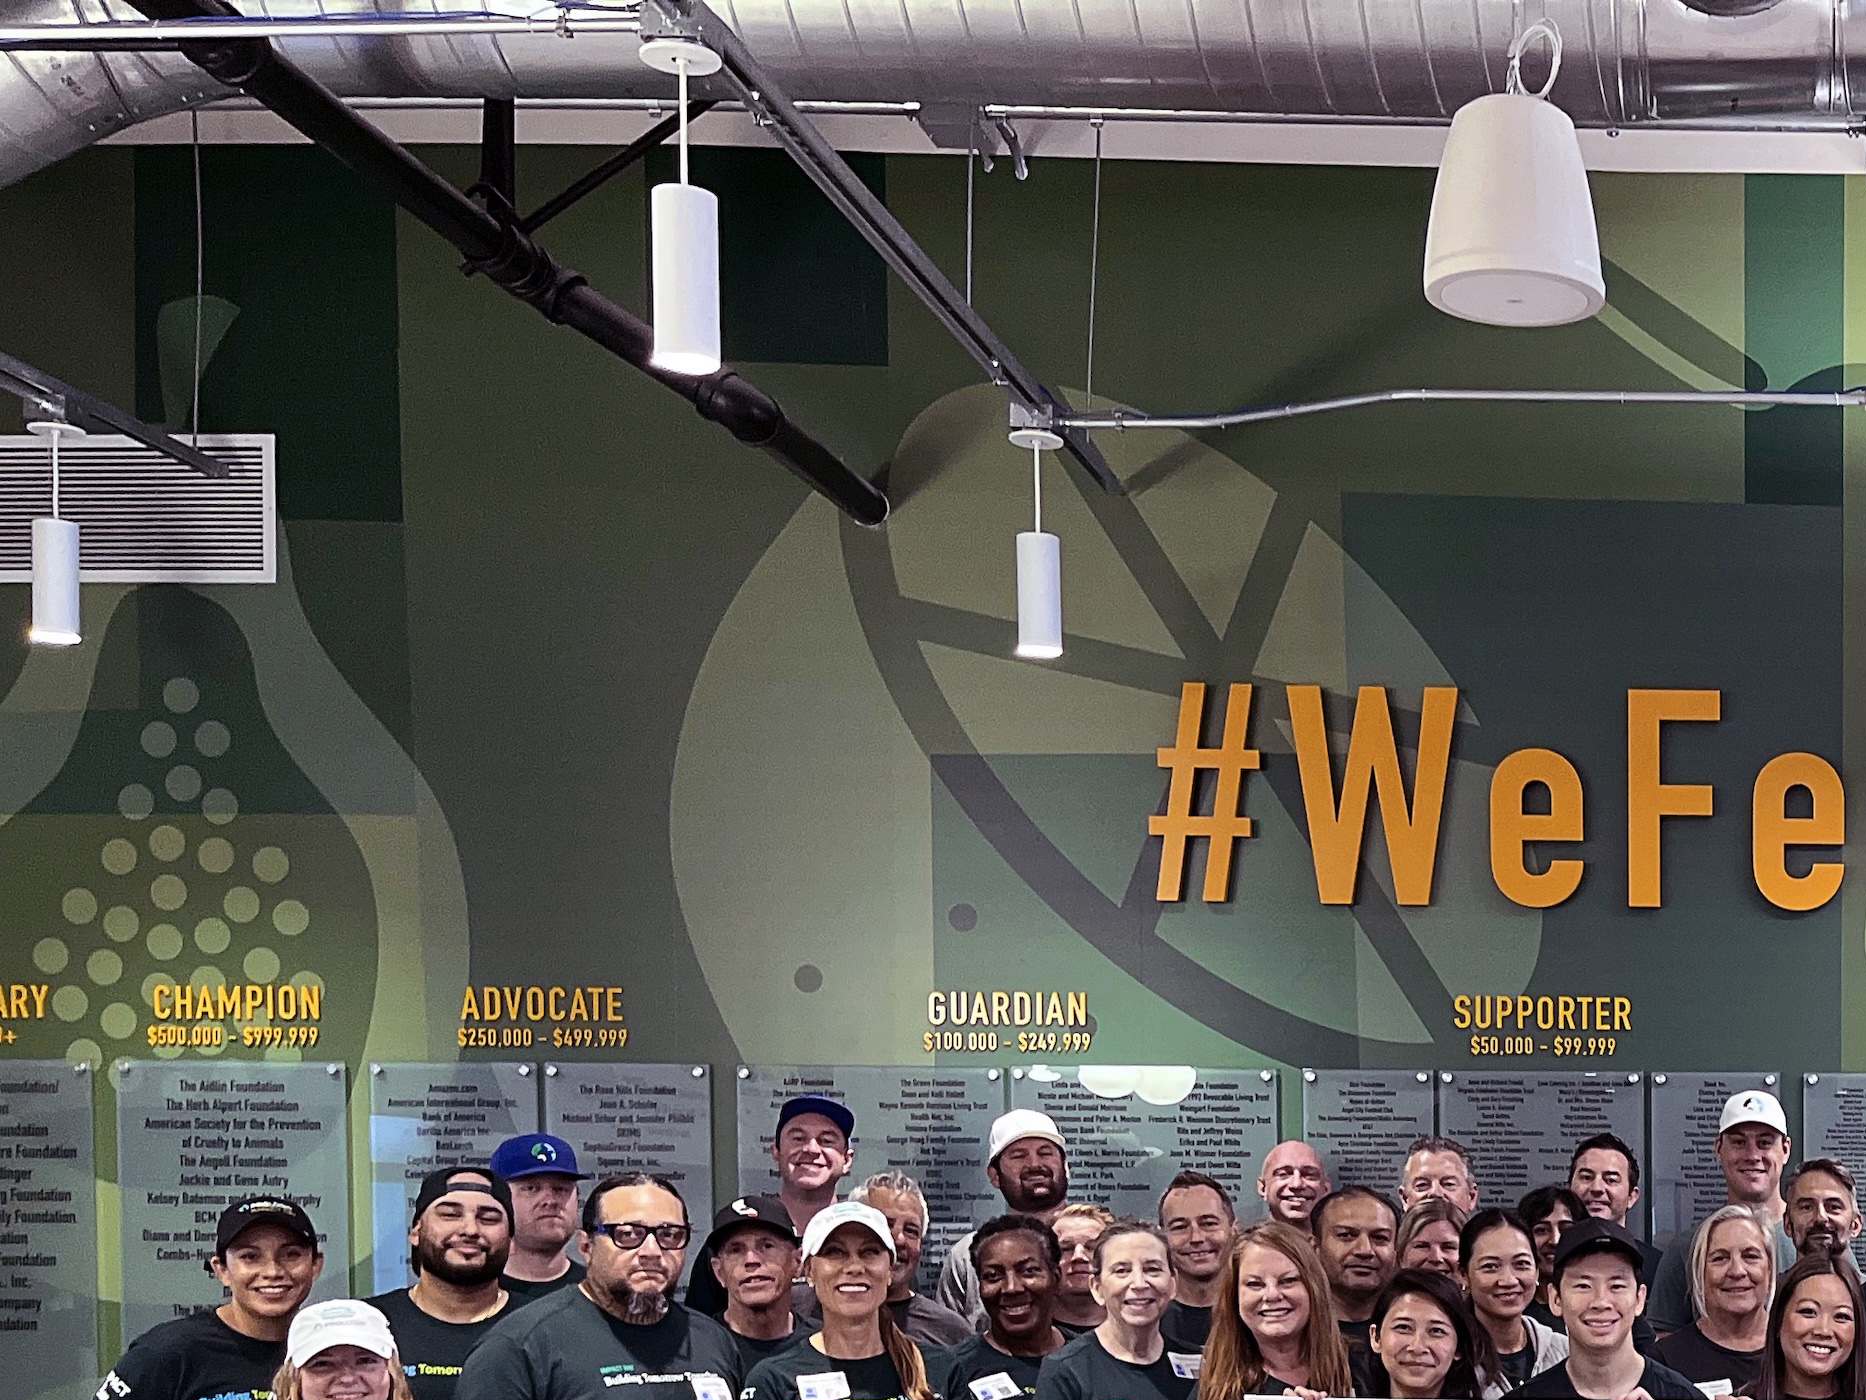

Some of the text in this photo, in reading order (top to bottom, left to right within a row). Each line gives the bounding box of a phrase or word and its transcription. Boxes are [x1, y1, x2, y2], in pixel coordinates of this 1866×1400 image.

[153, 984, 321, 1020] CHAMPION
[461, 987, 623, 1021] ADVOCATE
[927, 990, 1088, 1027] GUARDIAN
[1453, 994, 1632, 1031] SUPPORTER
[180, 1080, 196, 1092] The
[230, 1080, 285, 1092] Foundation
[635, 1085, 676, 1095] Foundation
[166, 1098, 183, 1111] The
[245, 1099, 299, 1111] Foundation
[144, 1117, 191, 1130] American
[234, 1118, 246, 1130] for
[269, 1118, 321, 1130] Prevention
[422, 1113, 442, 1121] Bank
[454, 1113, 486, 1121] America
[0, 1123, 48, 1136] undation
[182, 1136, 192, 1148] of
[244, 1137, 284, 1148] Animals
[633, 1142, 675, 1152] Foundation
[16, 1144, 77, 1158] Foundation
[180, 1155, 196, 1167] The
[233, 1155, 288, 1167] Foundation
[179, 1174, 288, 1188] Jackie and Gene Autry
[10, 1187, 72, 1202] Foundation
[15, 1210, 76, 1223] Foundation
[195, 1211, 217, 1223] BCM
[173, 1230, 191, 1241] and
[0, 1253, 56, 1266] oundation
